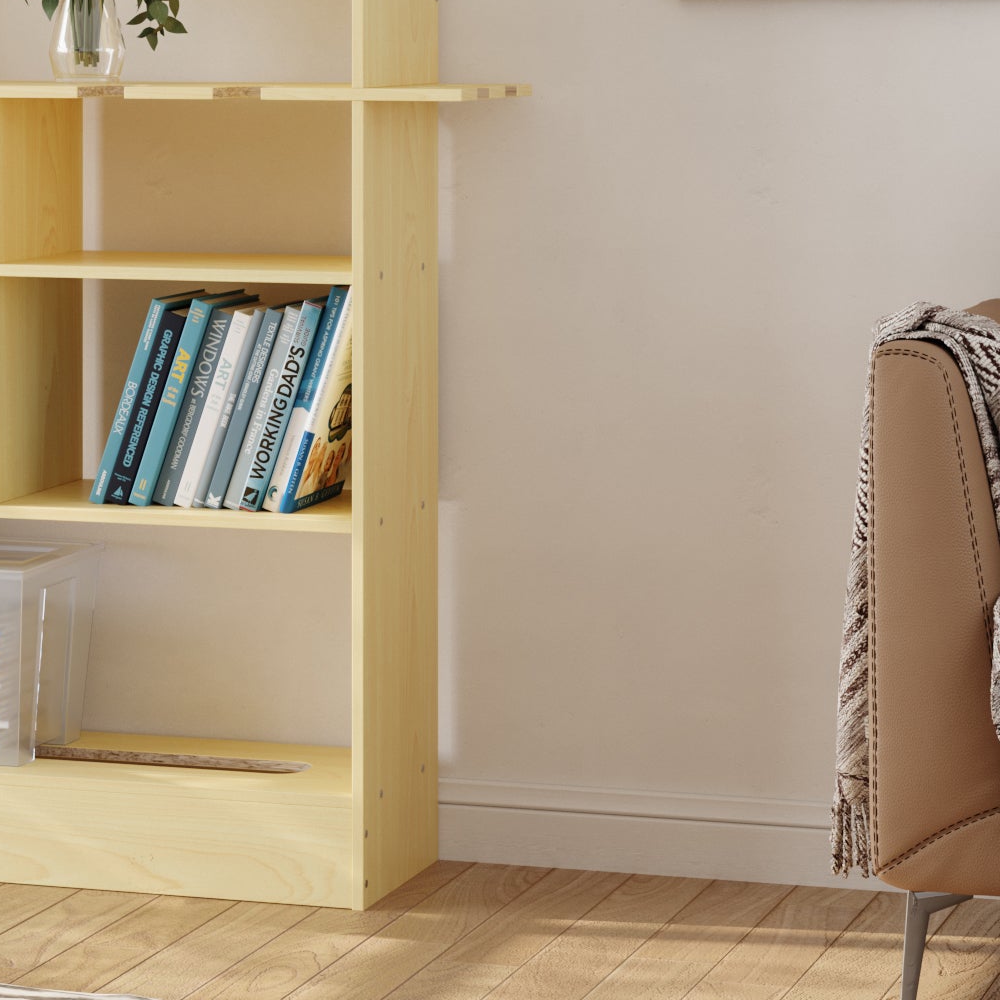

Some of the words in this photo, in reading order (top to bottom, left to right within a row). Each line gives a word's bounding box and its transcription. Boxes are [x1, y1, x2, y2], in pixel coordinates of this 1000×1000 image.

[152, 329, 173, 371] GRAPHIC
[264, 321, 278, 347] TEXTILE
[316, 331, 330, 357] ASPIRING
[171, 347, 191, 384] ART
[191, 319, 228, 398] WINDOWS
[251, 344, 269, 383] DESIGNERS
[309, 358, 322, 379] GRANT
[143, 373, 160, 406] DESIGN
[217, 359, 233, 393] ART
[264, 369, 280, 407] Gardens
[113, 380, 137, 436] BORDEAUX
[182, 404, 197, 438] BERGDORF
[250, 398, 288, 480] WORKING
[277, 345, 305, 399] DAD'S
[259, 407, 267, 422] in
[122, 407, 149, 468] REFERENCED
[170, 436, 186, 470] GOODMAN
[246, 421, 263, 455] France
